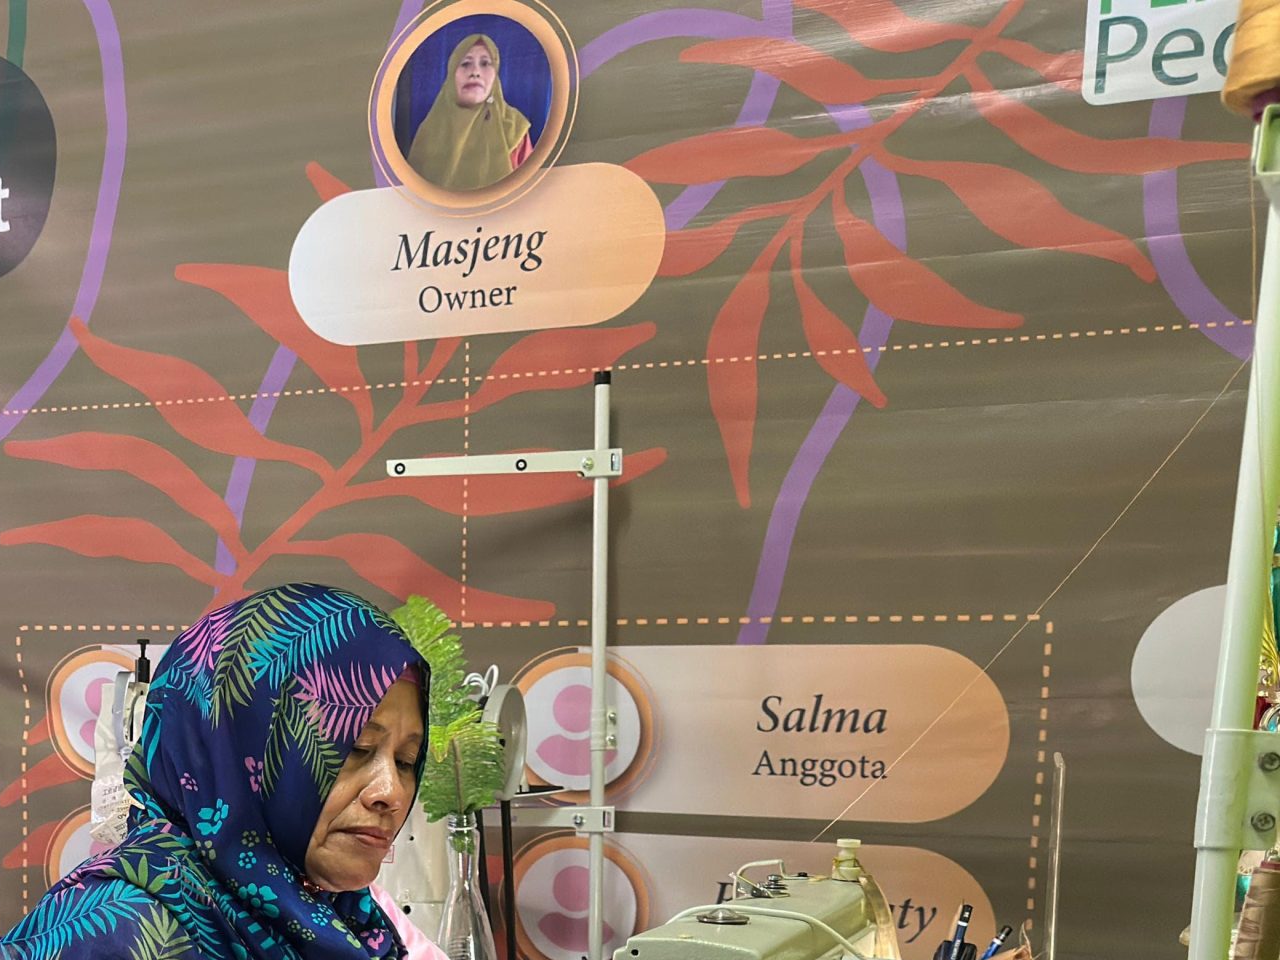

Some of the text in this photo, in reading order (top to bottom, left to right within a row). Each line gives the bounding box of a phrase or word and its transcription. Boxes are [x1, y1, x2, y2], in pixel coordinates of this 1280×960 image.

[390, 226, 548, 278] Masjeng
[418, 285, 518, 314] Owner
[756, 693, 888, 734] Salma
[751, 749, 888, 787] Anggota
